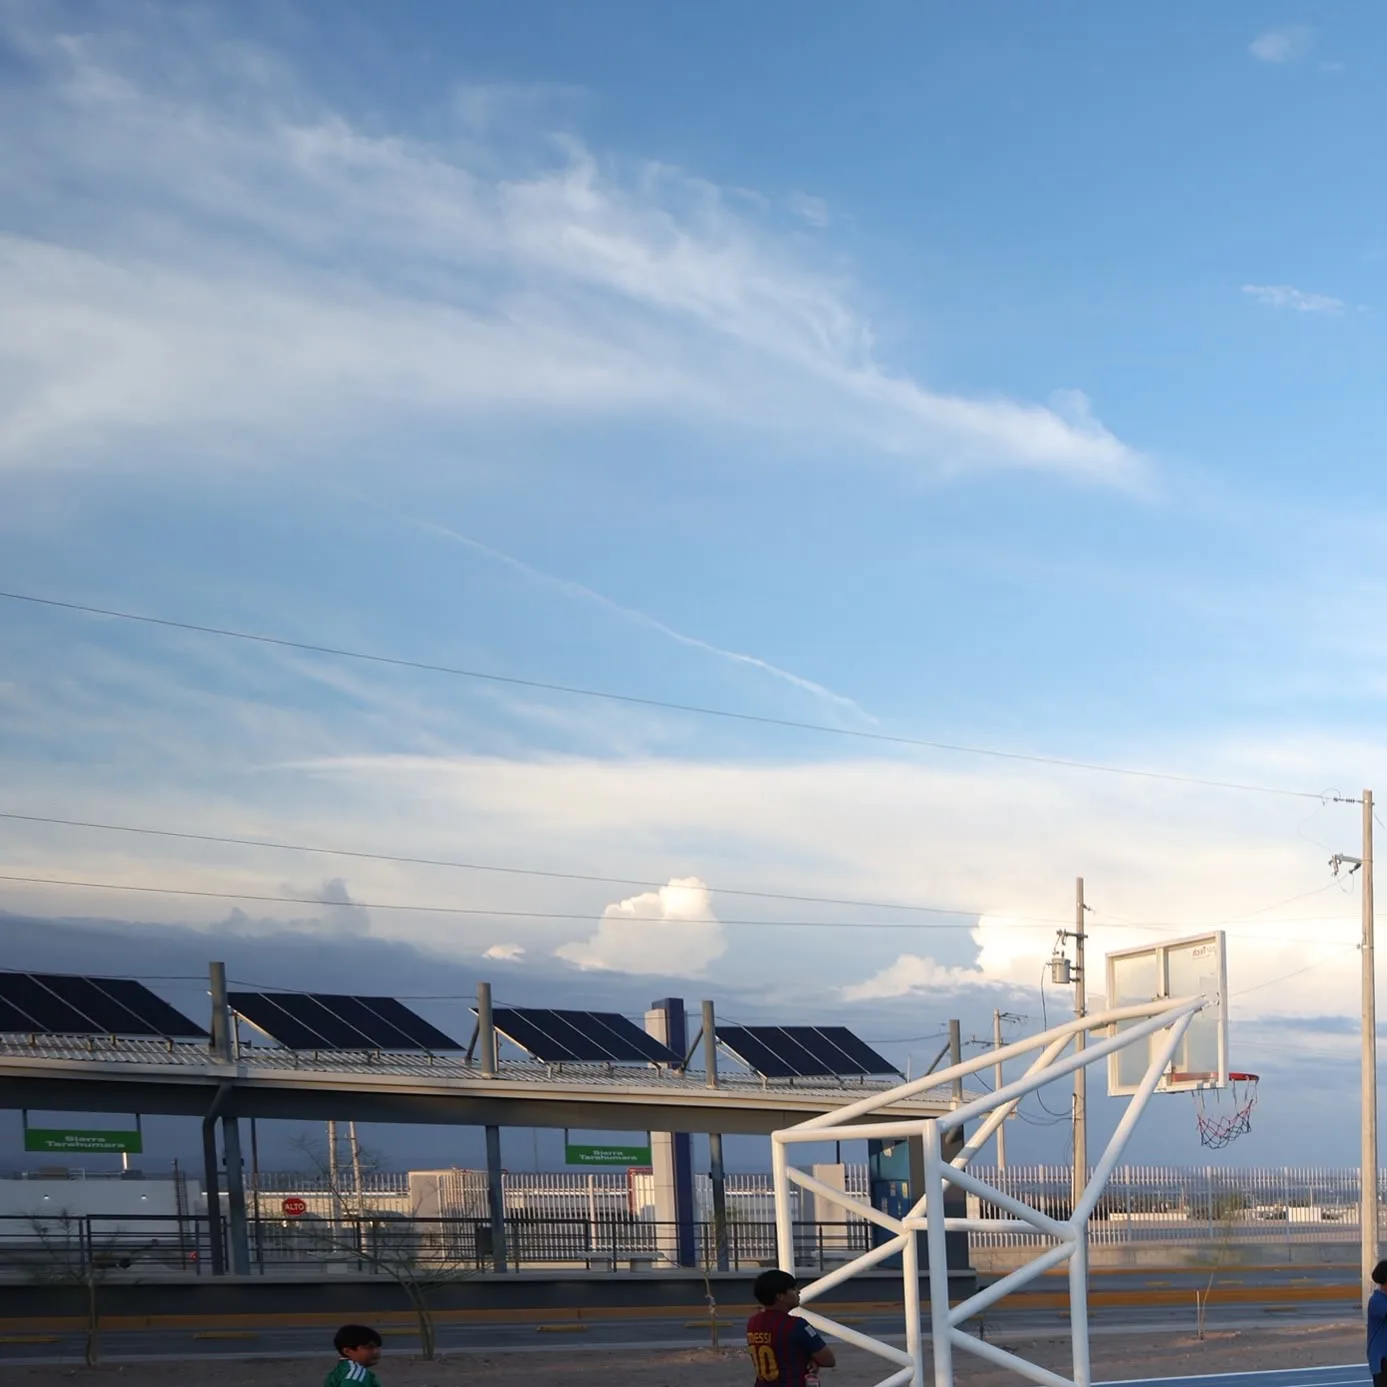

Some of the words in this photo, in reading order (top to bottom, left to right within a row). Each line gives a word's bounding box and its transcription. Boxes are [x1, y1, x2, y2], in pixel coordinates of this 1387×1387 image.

[64, 1135, 106, 1143] Sierra
[46, 1140, 125, 1148] Tarahumara
[284, 1203, 305, 1211] ALTO
[747, 1343, 780, 1382] 10
